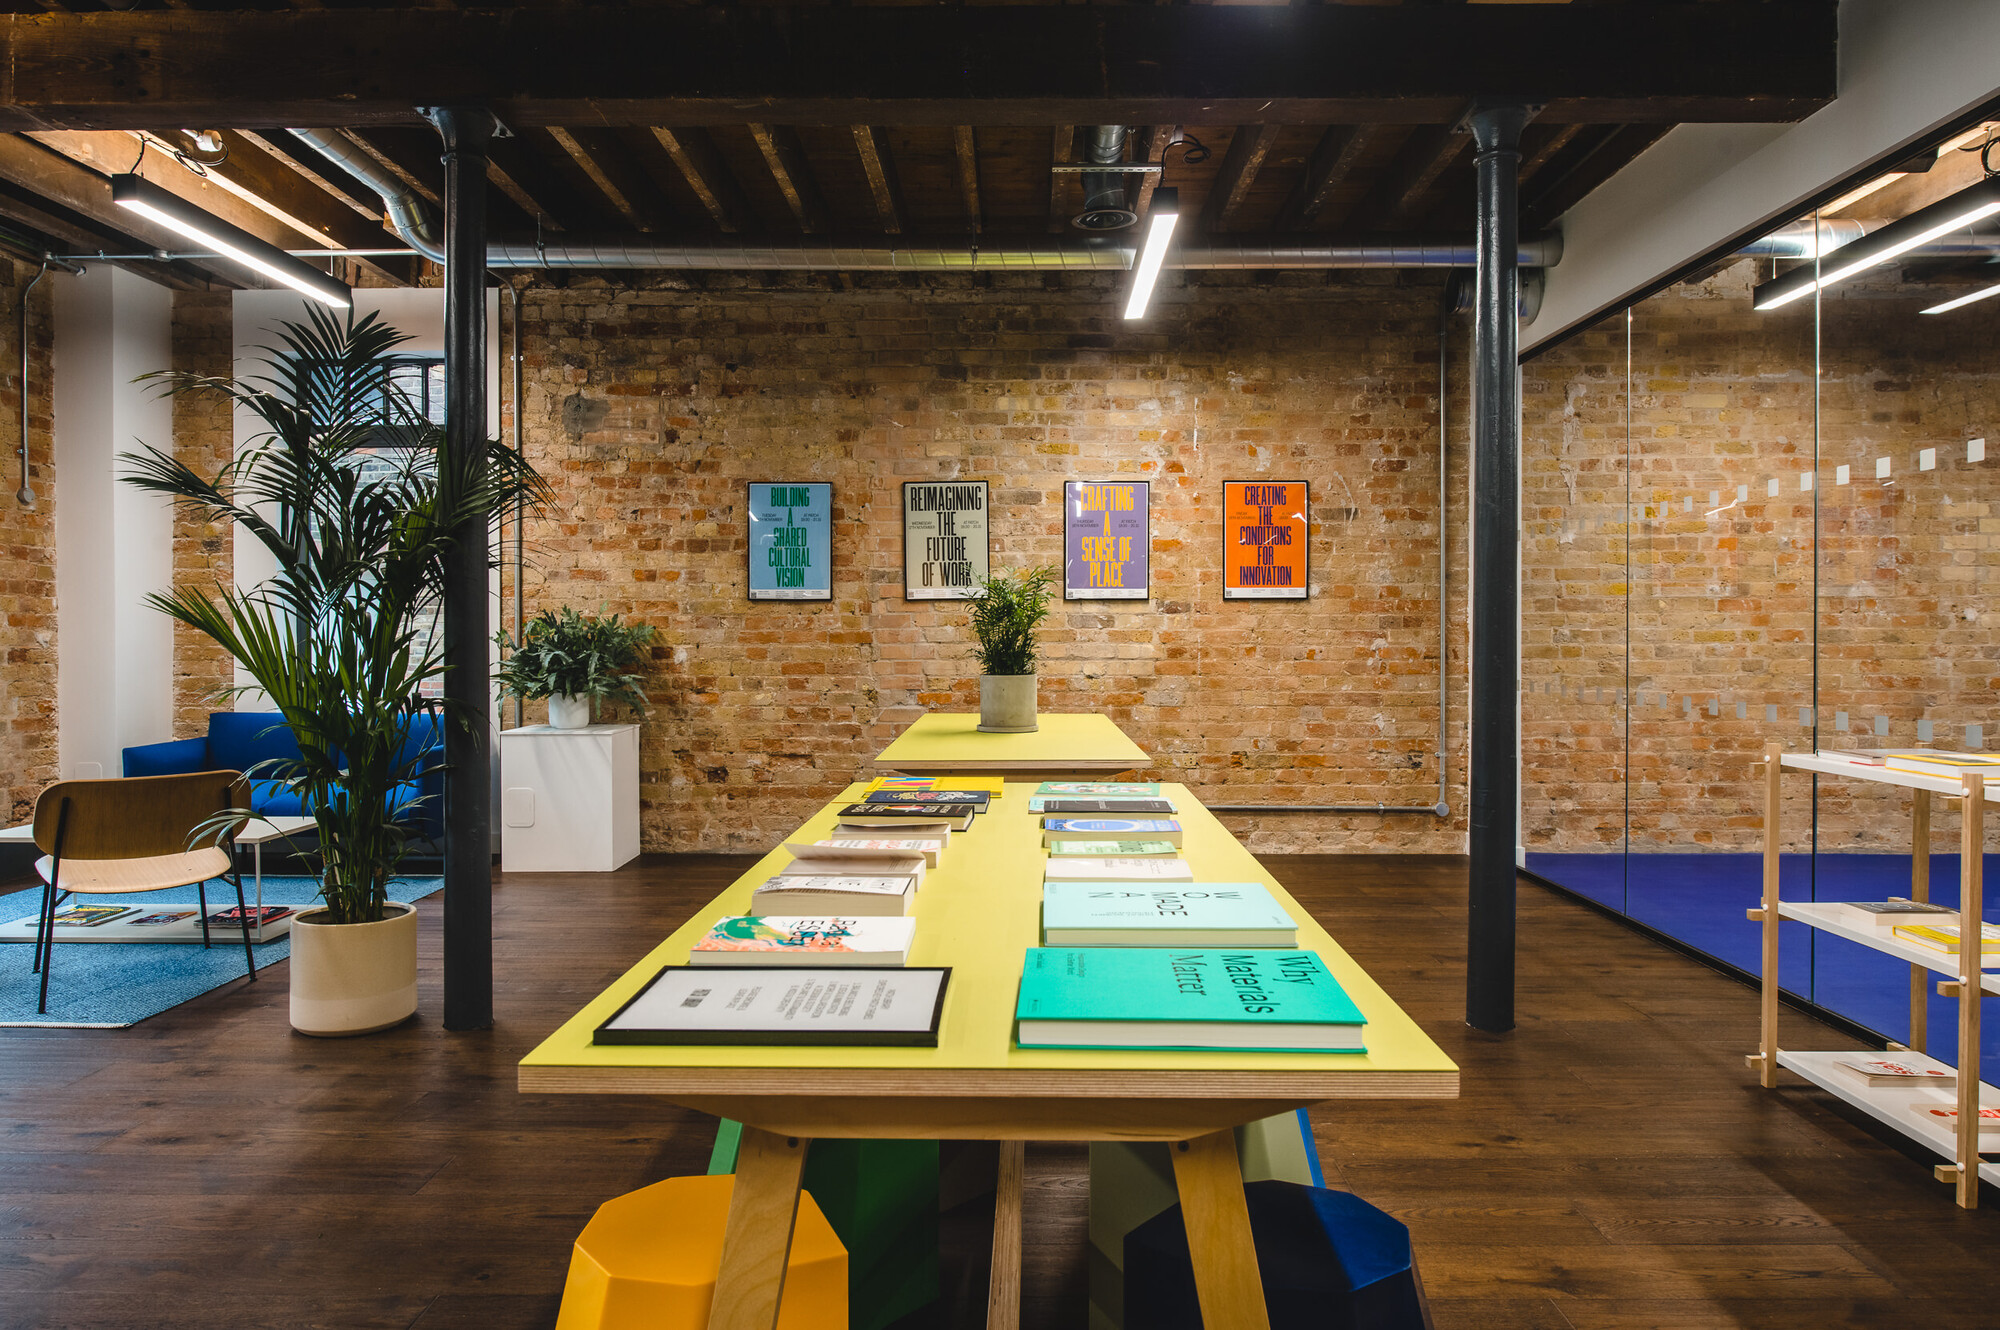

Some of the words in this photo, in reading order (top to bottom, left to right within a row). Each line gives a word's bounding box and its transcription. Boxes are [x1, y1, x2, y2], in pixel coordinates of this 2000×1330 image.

[770, 487, 810, 506] BUILDING
[910, 486, 981, 511] REIMAGINING
[1080, 486, 1134, 511] CRAFTING
[1245, 486, 1286, 506] CREATING
[787, 508, 793, 526] A
[936, 512, 956, 536] THE
[1103, 511, 1111, 536] A
[1258, 506, 1274, 525] THE
[774, 528, 807, 547] SHARED
[1240, 526, 1292, 545] CONDITIONS
[768, 547, 812, 567] CULTURAL
[926, 537, 967, 561] FUTURE
[1081, 537, 1116, 562] SENSE
[1119, 537, 1132, 562] OF
[1258, 546, 1274, 566] FOR
[776, 568, 804, 587] VISION
[922, 562, 934, 586] OF
[940, 562, 972, 586] WORK
[1090, 562, 1124, 587] PLACE
[1240, 566, 1292, 585] INNOVATION
[1168, 954, 1207, 996] Matter
[1273, 956, 1320, 985] Why
[1220, 955, 1281, 1014] Materials
